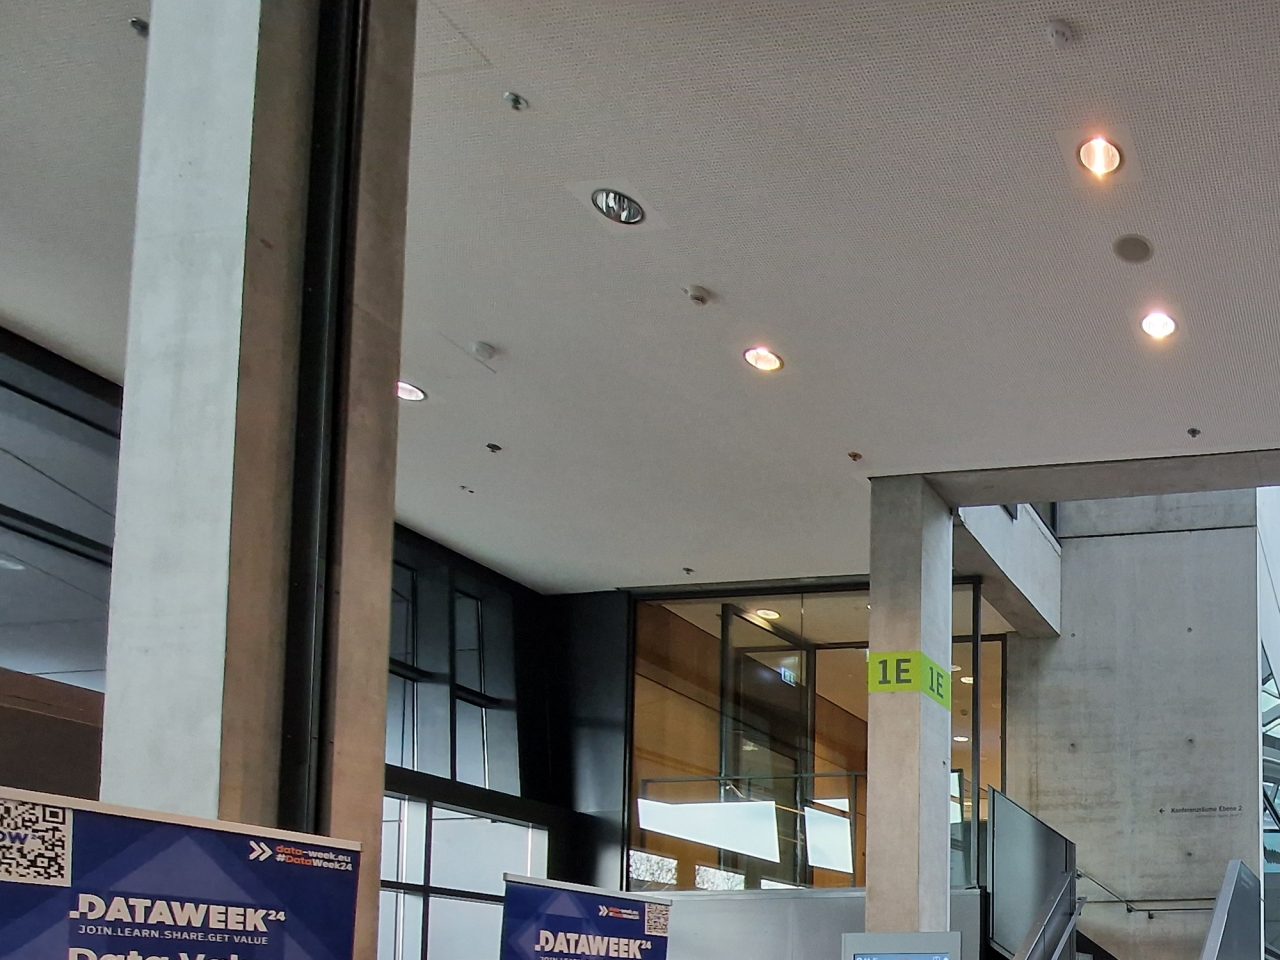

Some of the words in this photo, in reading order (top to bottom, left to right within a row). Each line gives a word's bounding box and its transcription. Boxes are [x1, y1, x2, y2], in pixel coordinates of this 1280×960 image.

[878, 658, 912, 685] 1E
[929, 666, 944, 699] 1E
[275, 845, 351, 862] data-week.eu
[276, 854, 353, 871] #DataWeek24
[234, 935, 268, 945] VALUE
